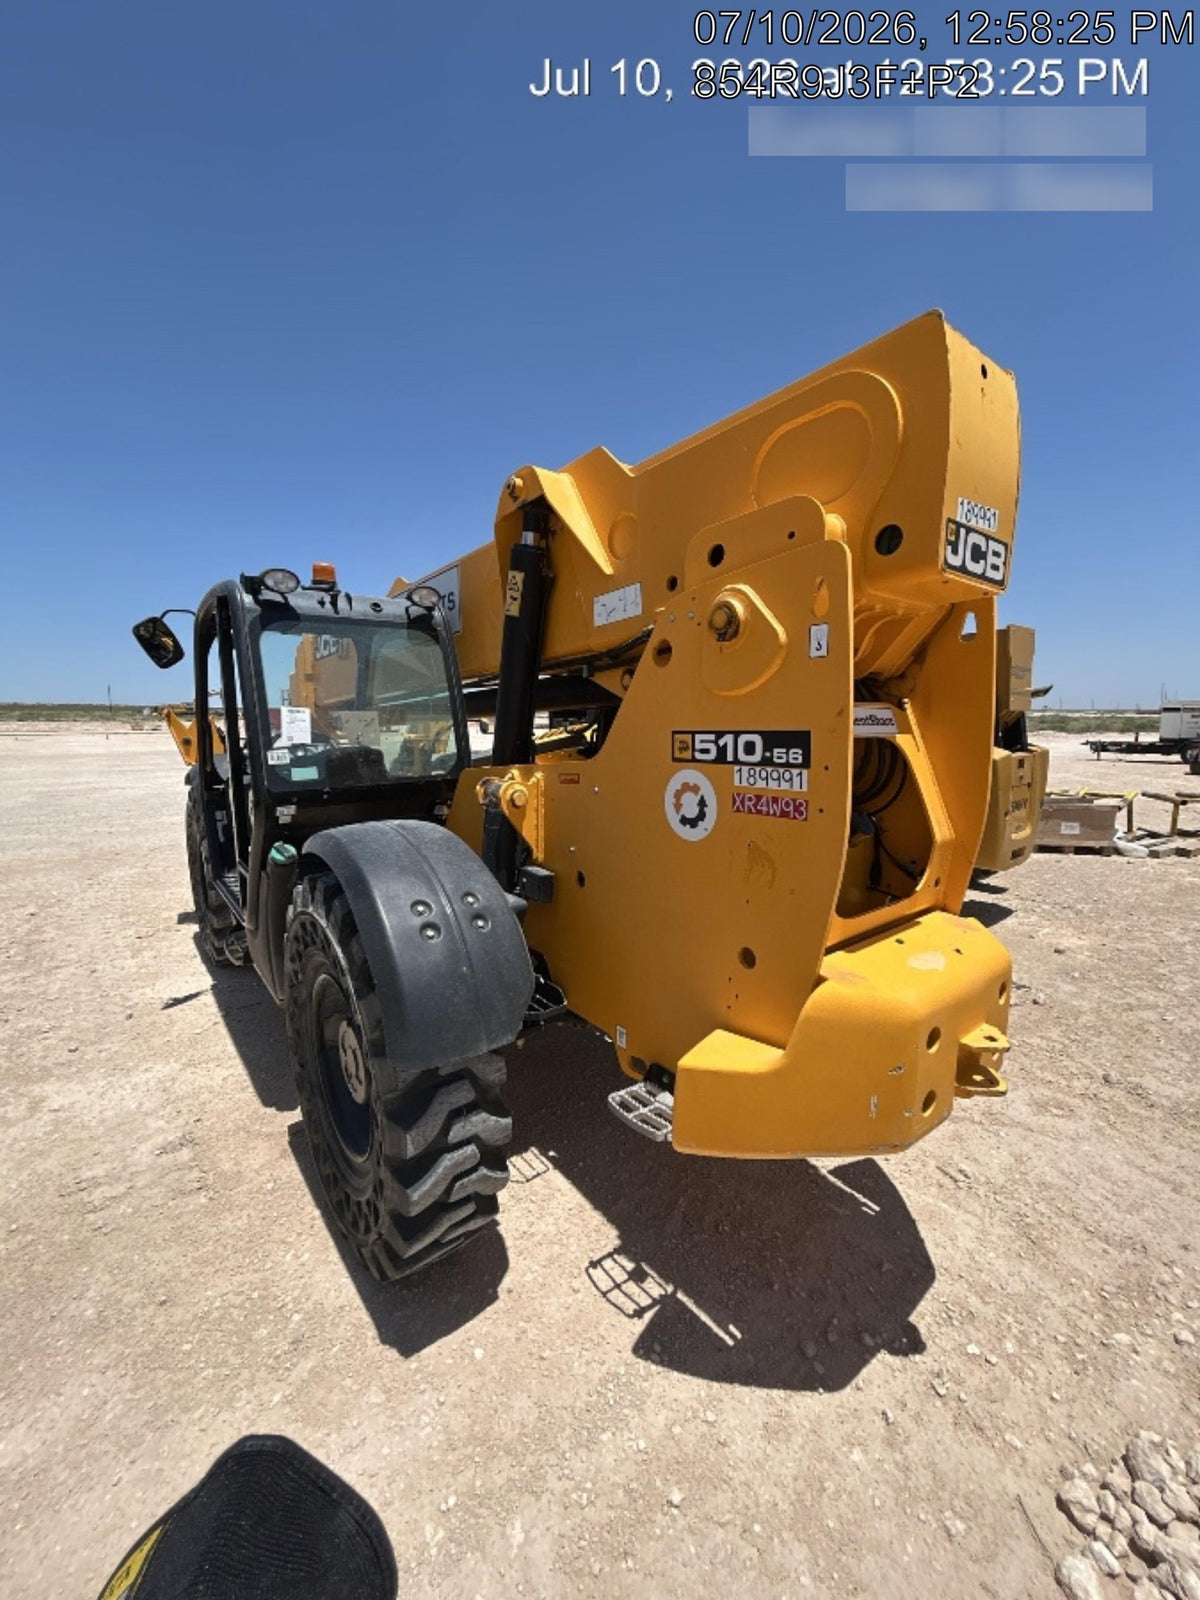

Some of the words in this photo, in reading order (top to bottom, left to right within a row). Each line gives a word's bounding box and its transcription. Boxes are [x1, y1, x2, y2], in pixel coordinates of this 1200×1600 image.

[945, 526, 1006, 581] JCB
[735, 766, 804, 790] 189991
[732, 793, 808, 821] XR4W93
